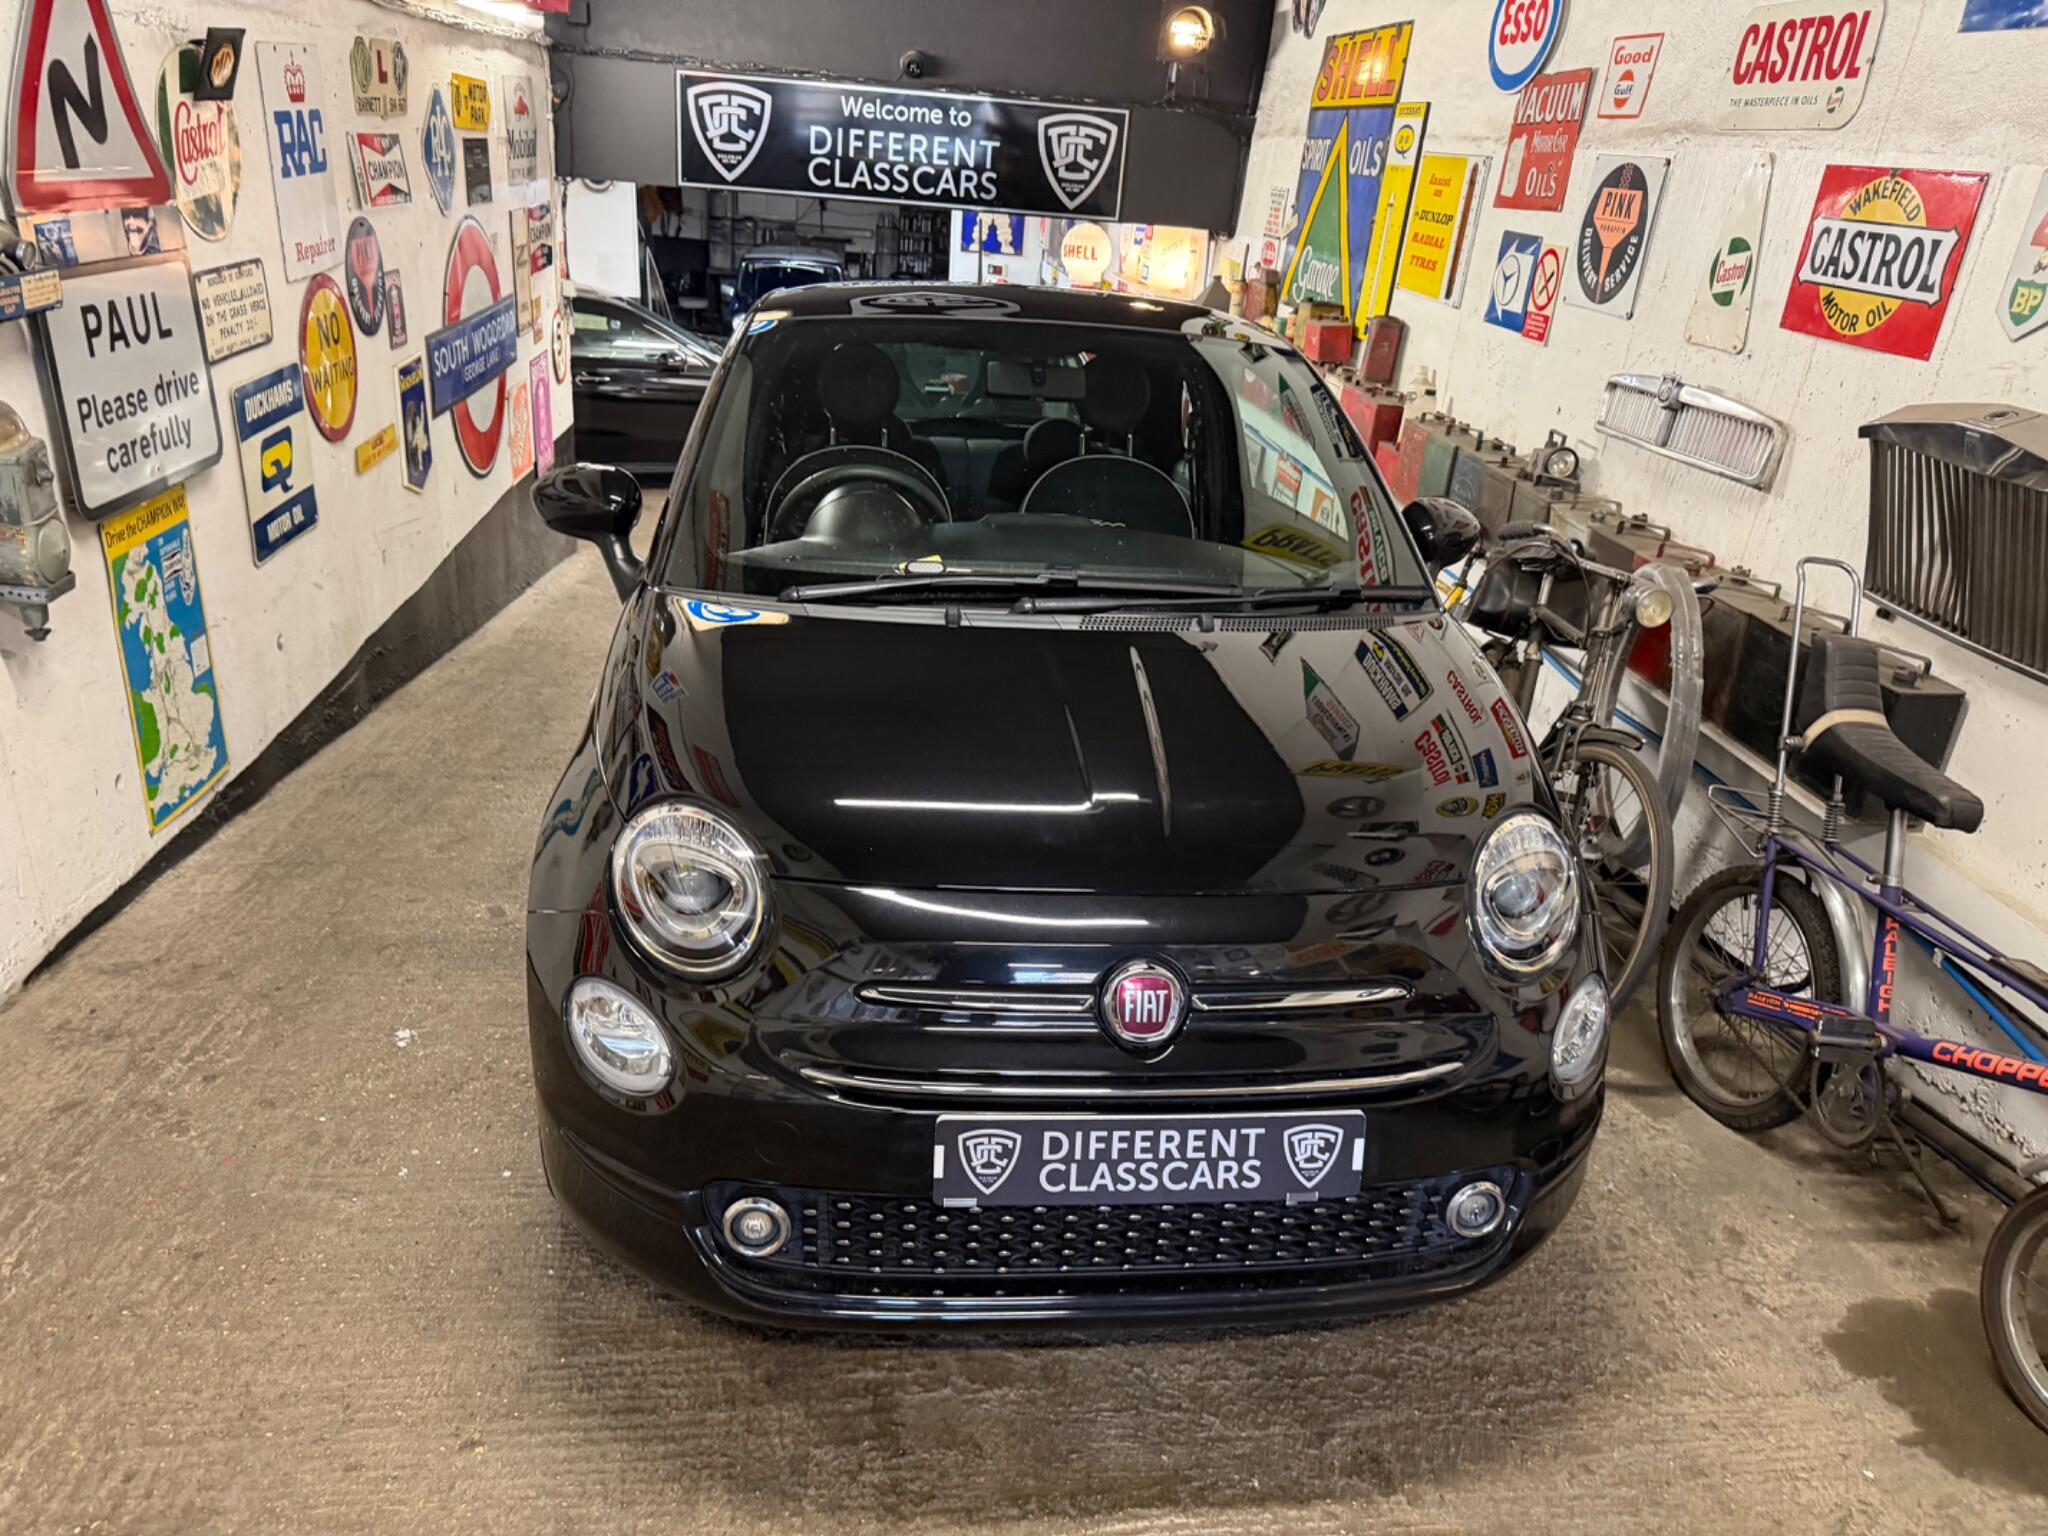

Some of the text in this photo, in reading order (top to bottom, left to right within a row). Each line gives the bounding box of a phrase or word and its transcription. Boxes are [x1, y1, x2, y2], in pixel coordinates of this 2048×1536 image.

[1499, 0, 1549, 45] ESSO
[1317, 33, 1398, 101] SHELL
[1614, 45, 1655, 66] Good
[1733, 10, 1872, 85] CASTROL
[1515, 81, 1586, 124] VACUUM
[1614, 80, 1634, 96] Gulf
[1743, 96, 1790, 107] MASTERPIECE
[1791, 96, 1800, 106] IN
[1801, 95, 1819, 106] OILS
[840, 96, 972, 128] Welcome to
[174, 101, 225, 186] Castrol
[274, 108, 327, 180] RAC
[809, 125, 1001, 170] DIFFERENT
[1349, 138, 1383, 178] OILS
[807, 158, 999, 201] CLASSCARS
[1419, 209, 1454, 226] DUNLOP
[1602, 191, 1636, 220] PINK
[1848, 179, 1923, 224] WAKEFIELD
[294, 235, 336, 265] Repairer
[1063, 243, 1098, 261] SHELL
[1411, 231, 1445, 249] RADIAL
[1581, 227, 1599, 289] DELIVERY
[1809, 226, 1944, 295] CASTROL
[1293, 245, 1339, 304] Garage
[1409, 254, 1438, 272] TYRES
[1604, 235, 1639, 292] SERVICE
[1716, 256, 1748, 284] Castrol
[1821, 290, 1893, 332] MOTOR OIL
[2010, 286, 2044, 315] BP
[80, 291, 174, 359] PAUL
[316, 311, 341, 351] NO
[310, 356, 355, 394] WAITING
[433, 335, 469, 378] SOUTH
[77, 368, 200, 434] Please drive
[244, 379, 293, 424] DUCKHAMS
[106, 413, 195, 475] carefully
[105, 527, 127, 549] Drive
[126, 521, 137, 539] the
[136, 501, 173, 533] CHAMPION
[266, 502, 305, 544] MOTOR OIL
[1125, 989, 1168, 1024] FIAT
[1042, 1127, 1266, 1161] DIFFERENT
[1039, 1160, 1262, 1193] CLASSCARS
